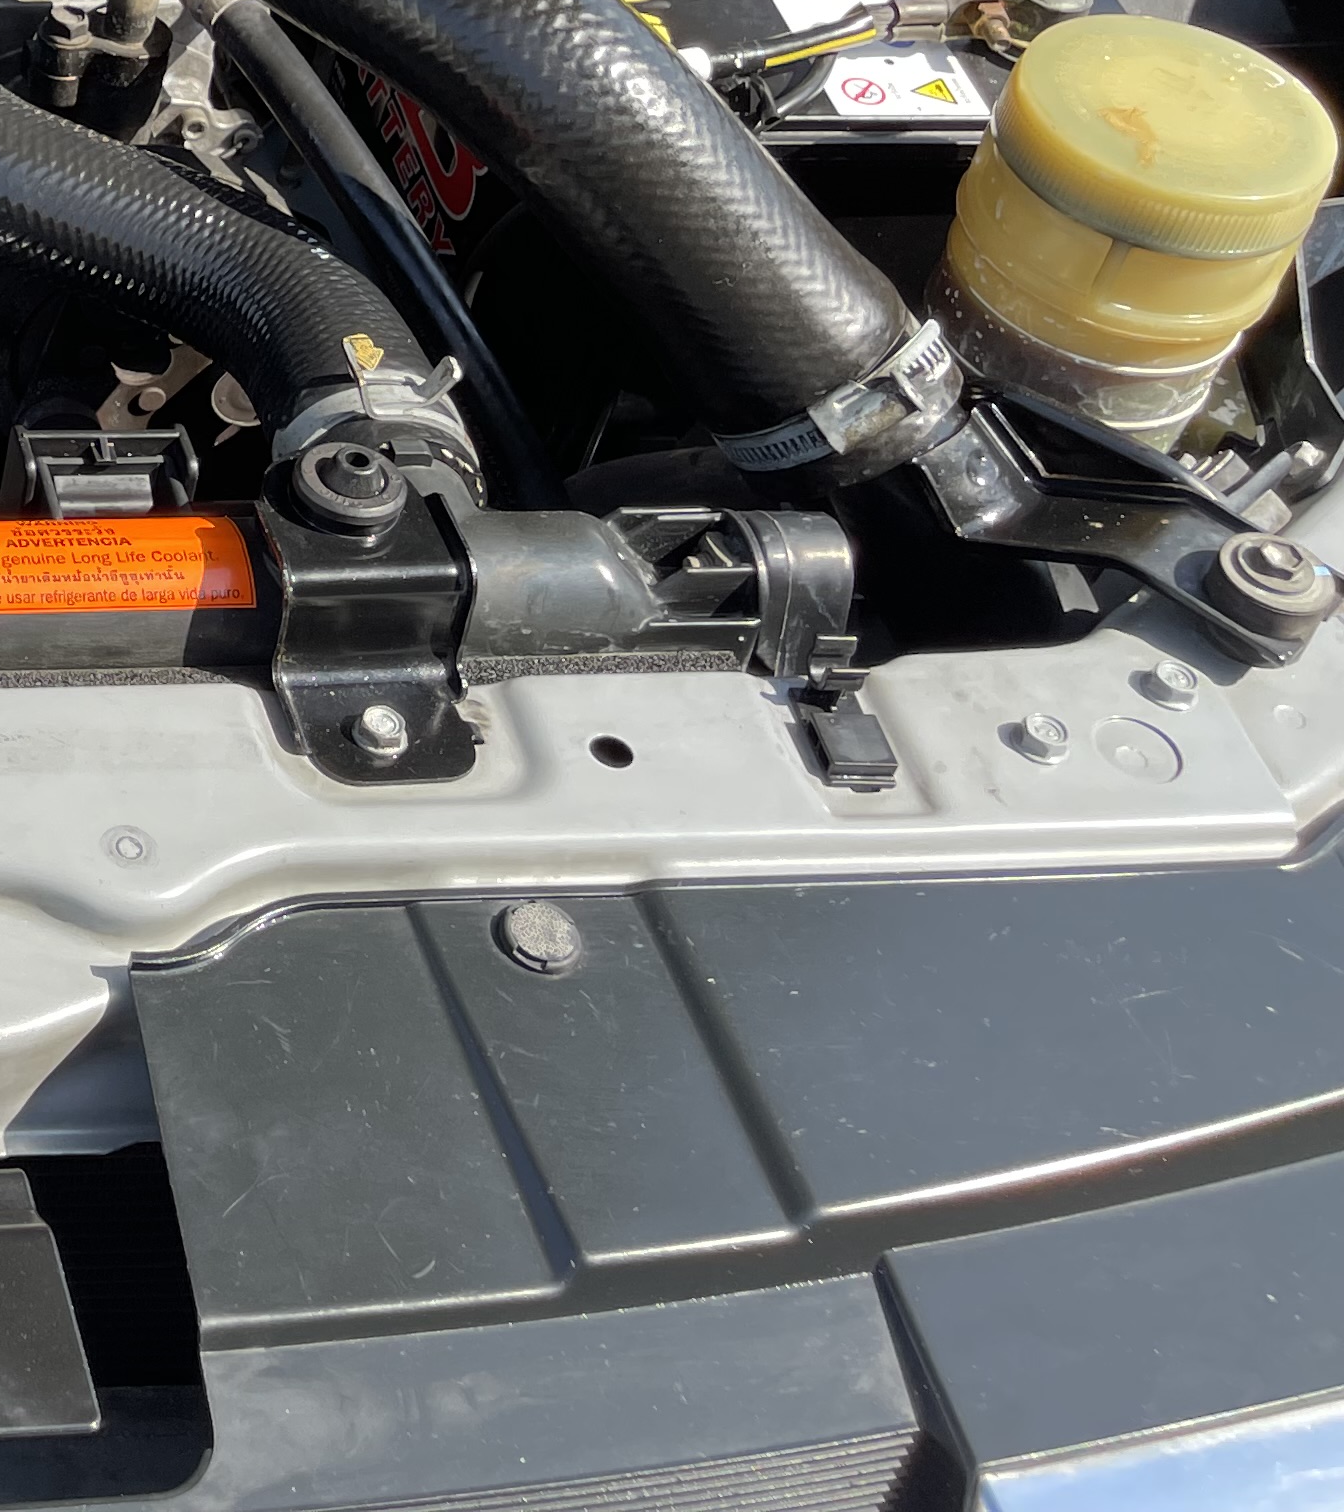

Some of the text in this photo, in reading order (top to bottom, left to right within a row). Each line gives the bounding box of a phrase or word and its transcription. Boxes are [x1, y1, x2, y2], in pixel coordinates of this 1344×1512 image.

[5, 536, 132, 548] ADVERTENCIA
[1, 553, 66, 570] genuine
[71, 552, 113, 566] Long
[115, 551, 146, 564] Life
[151, 550, 219, 563] Coolant.
[6, 591, 36, 604] usar
[40, 589, 116, 606] refrigerante
[120, 588, 137, 602] de
[142, 588, 175, 604] larga
[178, 587, 206, 600] vida
[211, 588, 245, 602] puro.
